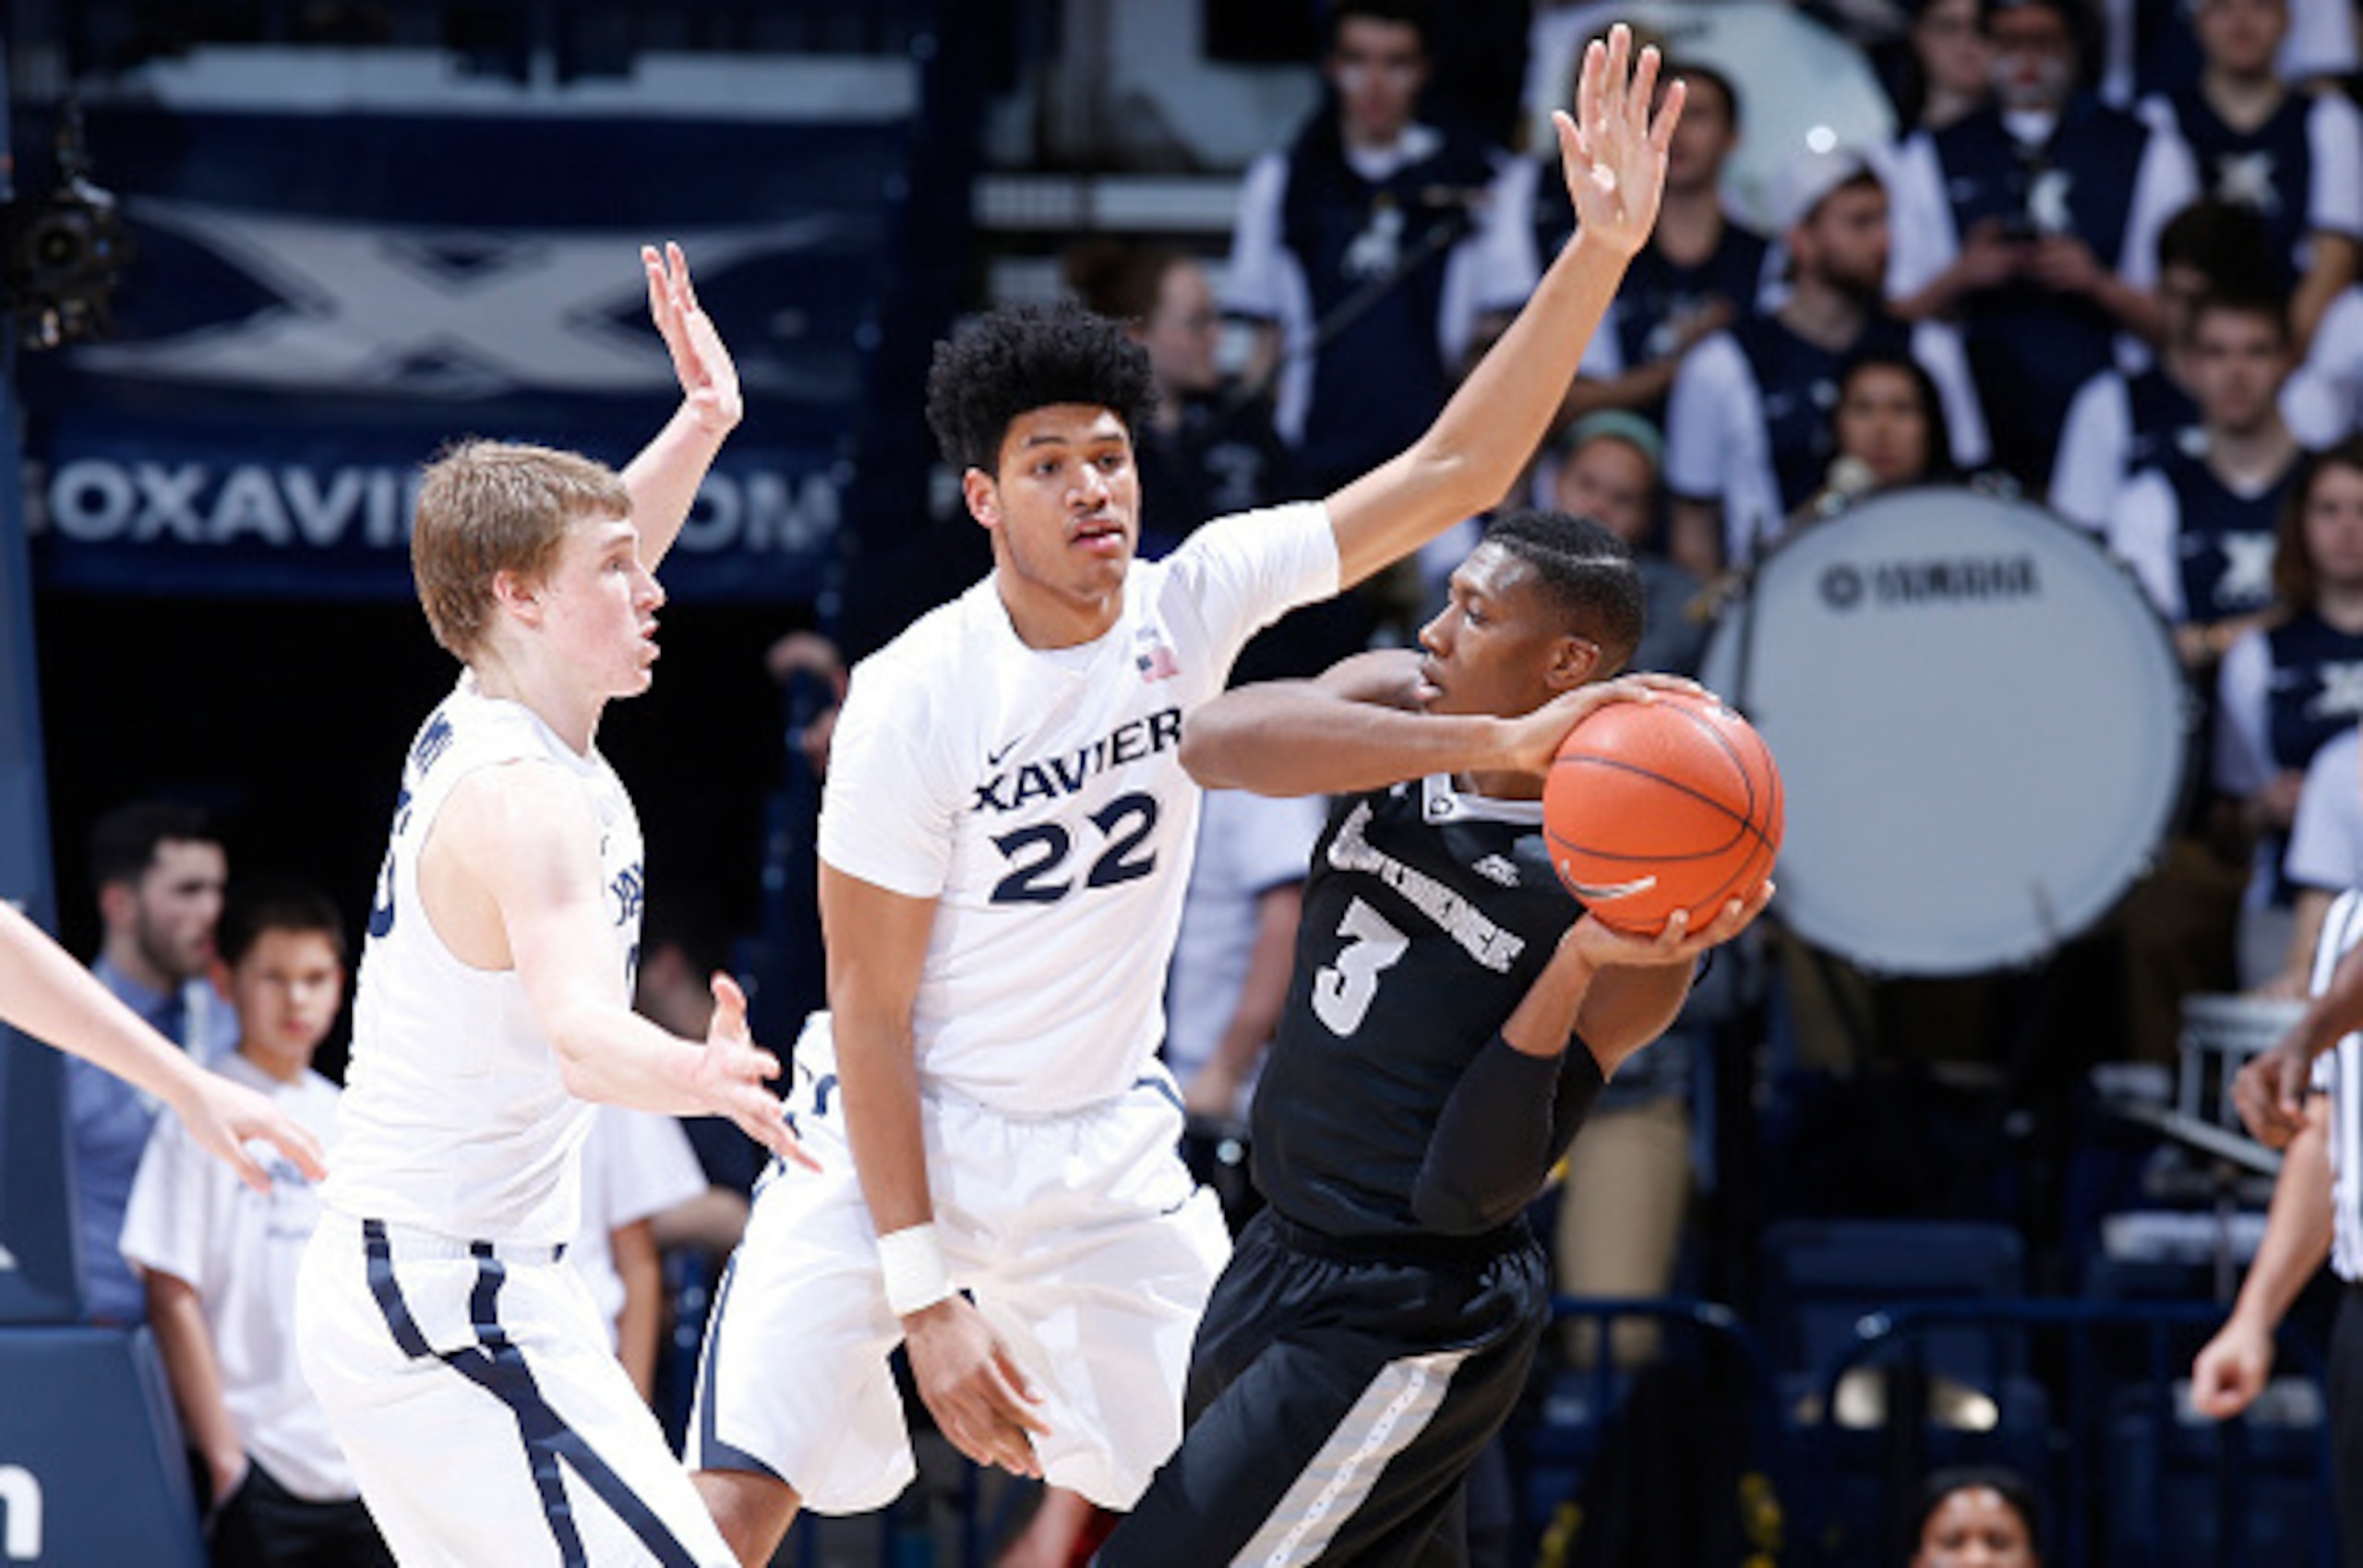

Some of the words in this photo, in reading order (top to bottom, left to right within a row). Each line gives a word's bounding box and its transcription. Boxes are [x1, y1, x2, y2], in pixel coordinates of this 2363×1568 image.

[972, 705, 1182, 813] XAVIER
[989, 791, 1158, 904] 22
[1311, 895, 1410, 1037] 3
